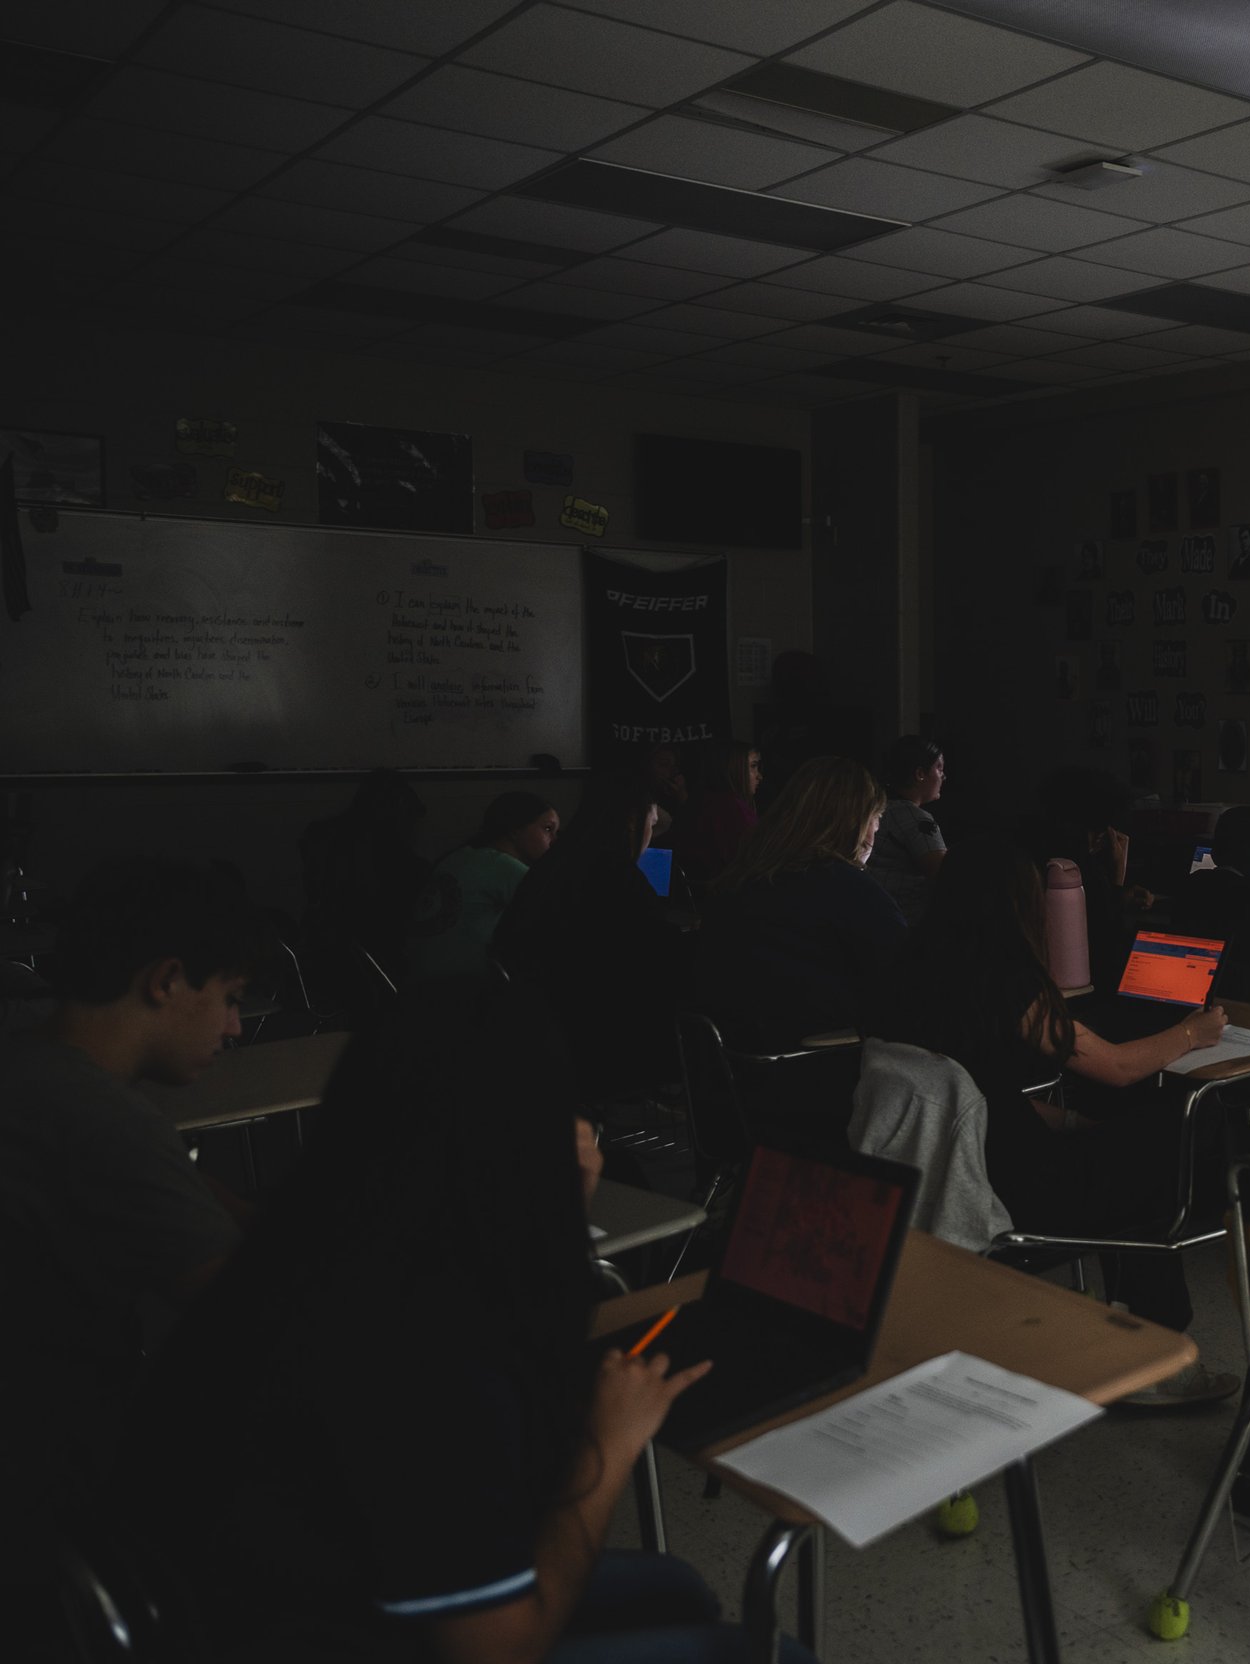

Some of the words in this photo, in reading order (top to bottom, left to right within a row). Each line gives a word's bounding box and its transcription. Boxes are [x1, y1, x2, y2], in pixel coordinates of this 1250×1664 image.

[230, 473, 286, 500] support
[1183, 539, 1214, 571] Made
[408, 598, 425, 609] can
[606, 589, 709, 611] PFEIFFER
[1210, 594, 1231, 620] In
